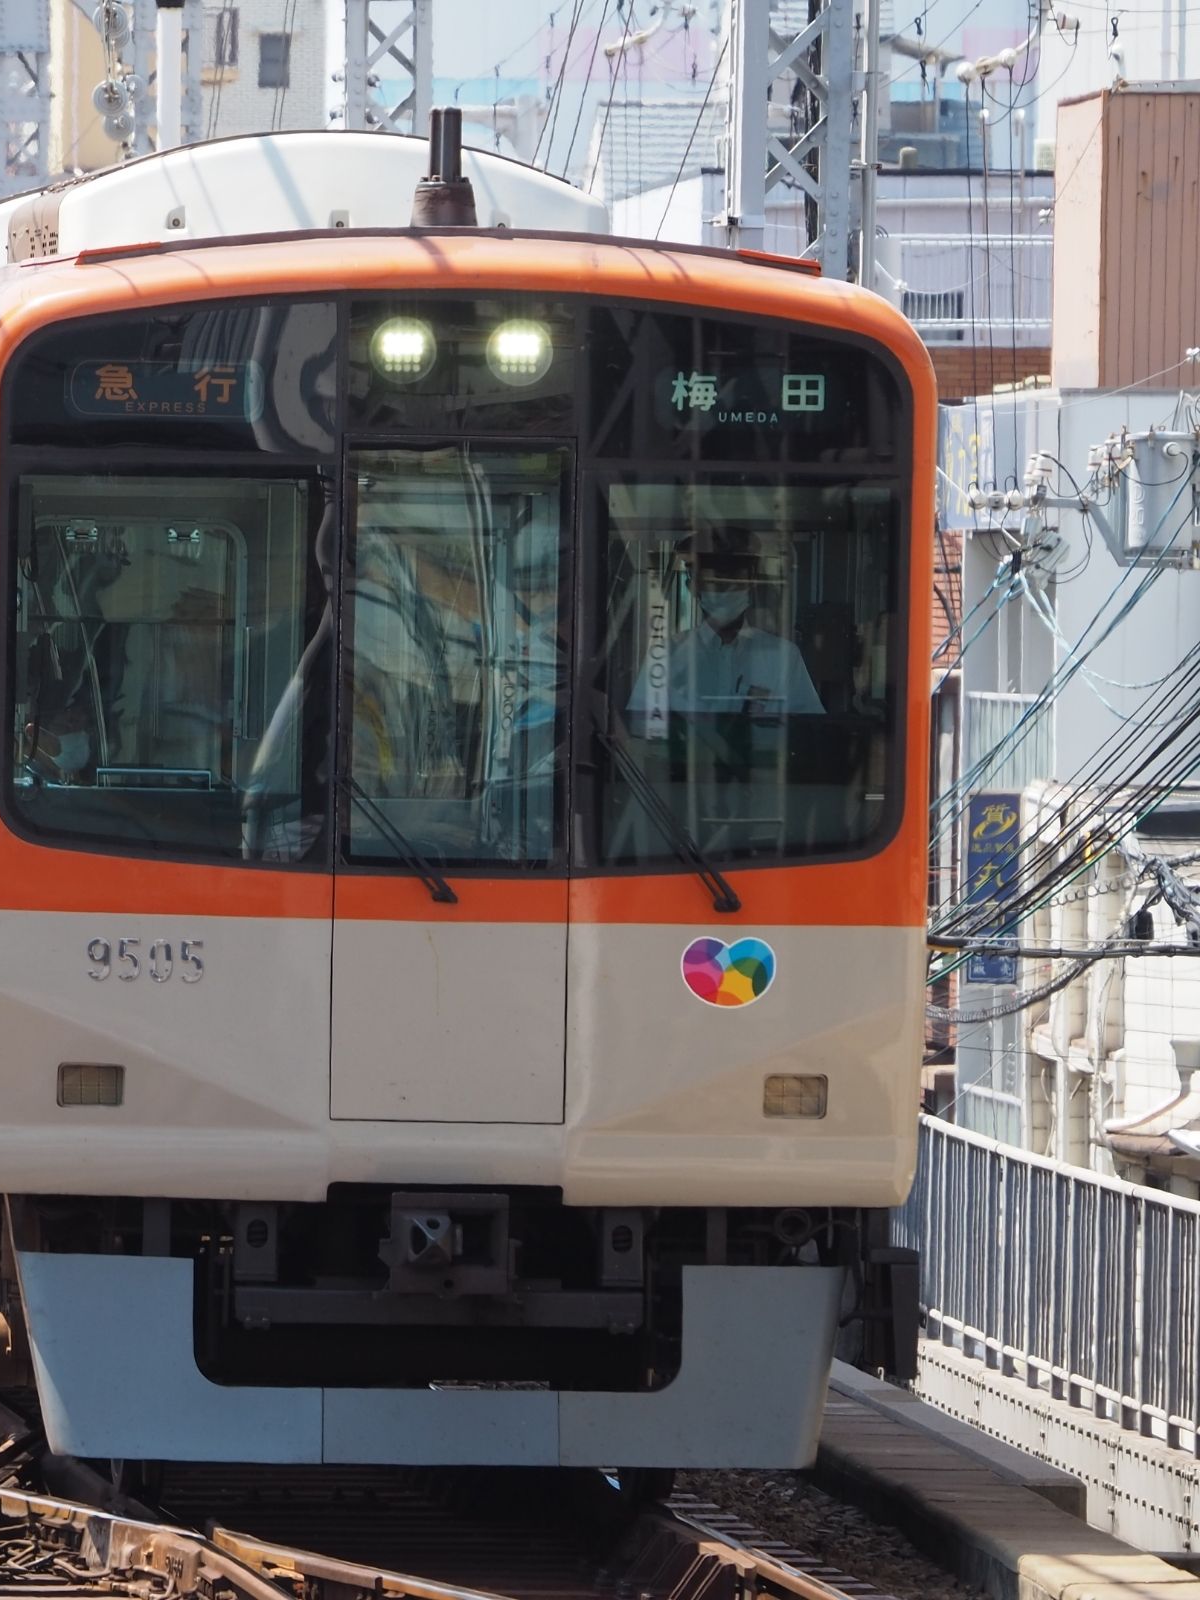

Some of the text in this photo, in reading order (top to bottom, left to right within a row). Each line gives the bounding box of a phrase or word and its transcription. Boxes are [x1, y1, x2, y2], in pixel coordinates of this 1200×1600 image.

[94, 363, 237, 404] 急行
[671, 371, 825, 412] 梅田
[125, 401, 207, 414] EXPRESS
[718, 411, 779, 424] UMEDA
[87, 936, 205, 984] 9505
